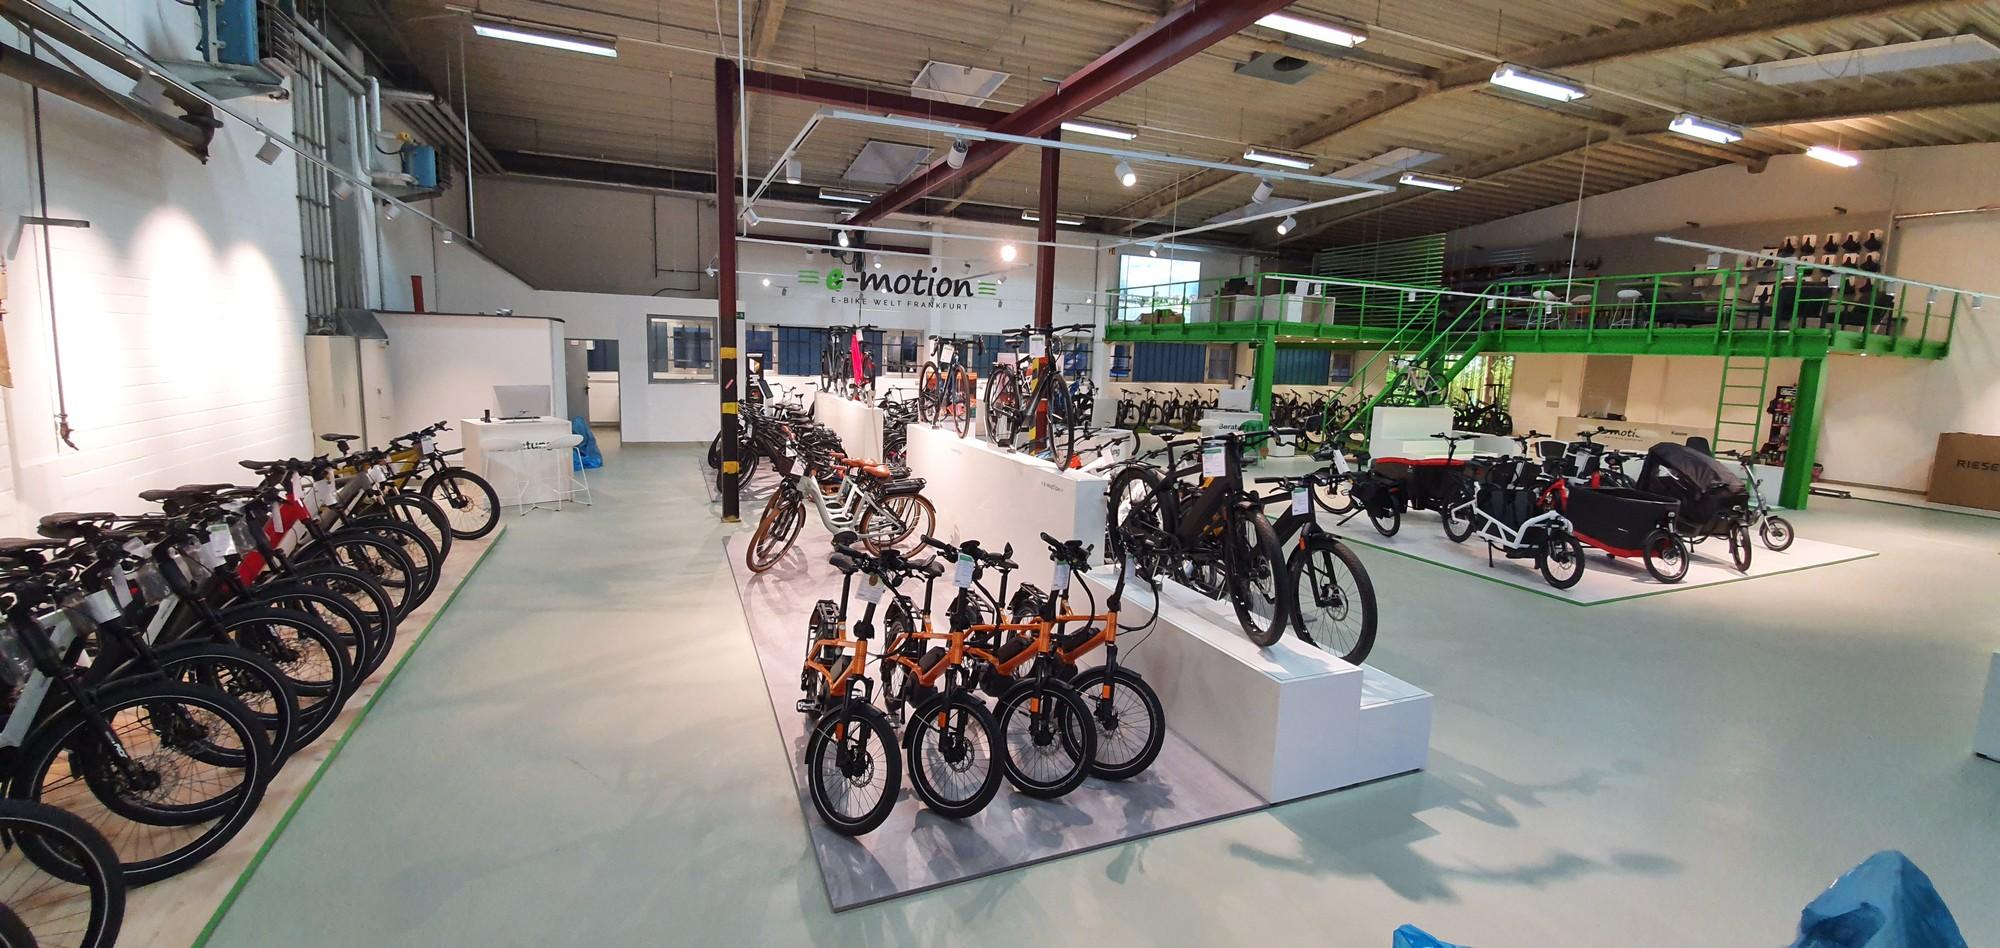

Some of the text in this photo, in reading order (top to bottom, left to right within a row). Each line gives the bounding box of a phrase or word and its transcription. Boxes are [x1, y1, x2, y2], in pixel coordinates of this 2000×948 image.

[826, 266, 974, 298] e-motion
[831, 296, 969, 311] E-BIKE WELT FRANKFURT
[1956, 459, 2000, 472] RIESE
